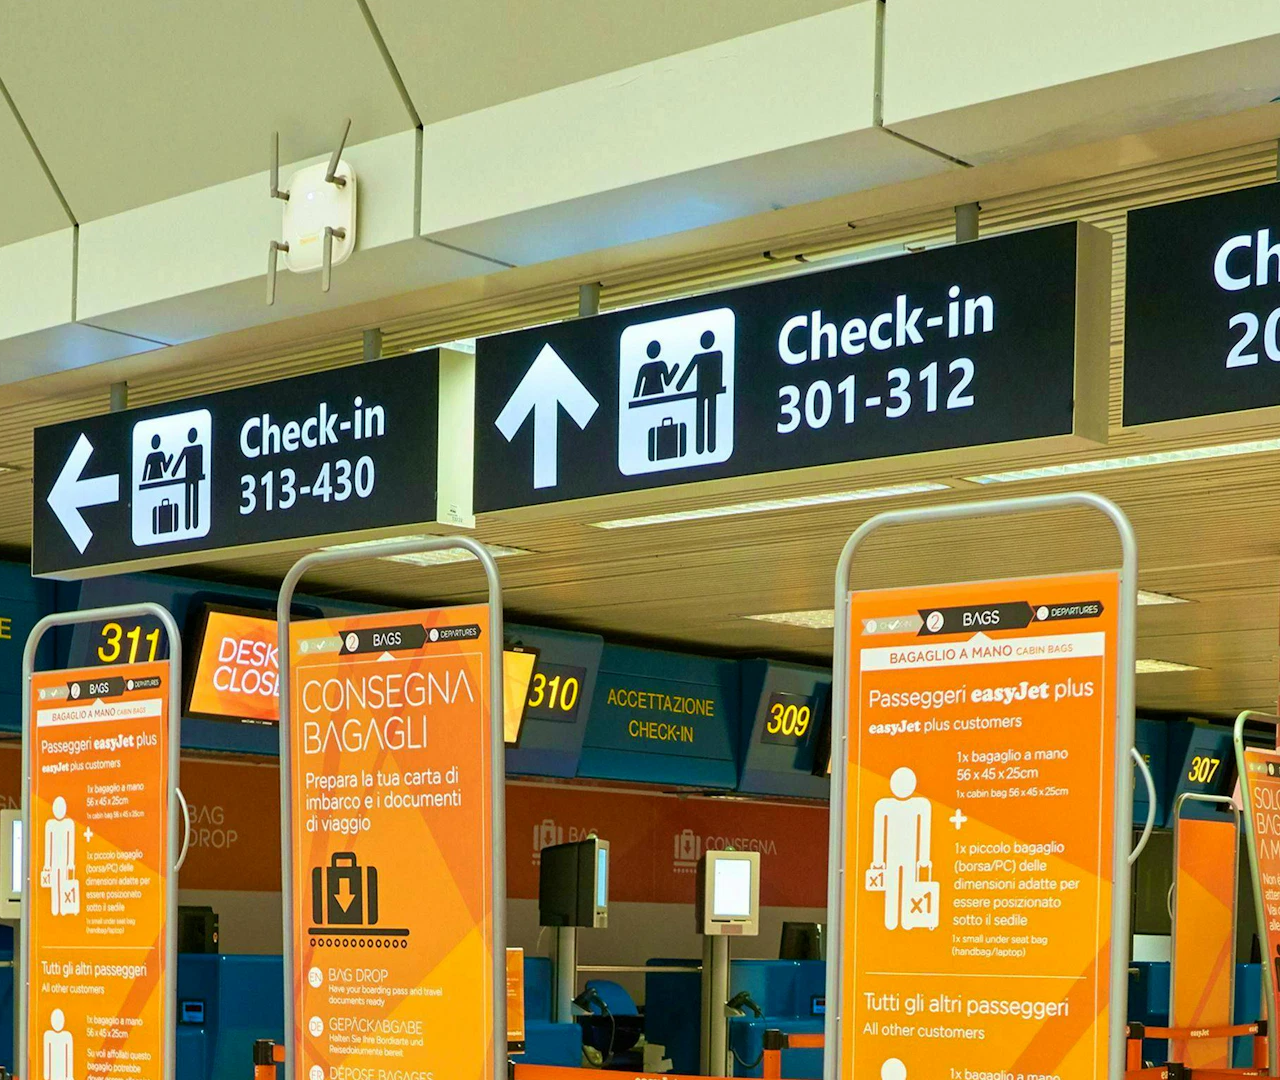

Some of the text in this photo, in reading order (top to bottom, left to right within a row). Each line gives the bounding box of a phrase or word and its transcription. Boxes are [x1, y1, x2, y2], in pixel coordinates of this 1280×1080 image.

[777, 285, 994, 365] Check-in
[776, 357, 976, 434] 301-312
[239, 395, 385, 458] Check-in
[239, 455, 375, 515] 313-430
[963, 605, 1098, 626] BAGS DEPARTURES
[98, 622, 161, 664] 311
[373, 628, 477, 646] BAGS DEPARTURES
[218, 637, 280, 668] DESK
[890, 644, 1073, 664] BAGAGLIO A MANO CABIN BAGS
[90, 682, 109, 695] BAGS
[302, 669, 474, 713] CONSEGNA
[528, 673, 578, 711] 310
[869, 677, 1094, 709] Passeggeri easyJet plus
[607, 688, 714, 717] ACCETTAZIONE
[52, 707, 115, 722] BAGAGLIO A MANO
[767, 703, 810, 736] 309
[869, 715, 1022, 736] easyJet plus customers
[41, 731, 157, 753] Passeggeri easyJet plus
[304, 716, 427, 754] BAGAGLI
[629, 720, 694, 742] CHECK-IN
[42, 760, 120, 773] easyJet plus customers
[1188, 756, 1219, 783] 307
[306, 766, 458, 790] Prepara la tua carta di
[306, 789, 461, 810] imbarco e i documenti
[306, 815, 370, 835] di viaggio
[1260, 839, 1269, 859] A
[869, 873, 884, 887] x1
[910, 892, 932, 914] x1
[329, 968, 388, 983] BAG DROP
[329, 985, 443, 997] Have your boarding pass and travel
[863, 992, 1069, 1020] Tutti gli altri passeggeri
[863, 1022, 985, 1040] All other customers
[1190, 1029, 1209, 1037] easyJet
